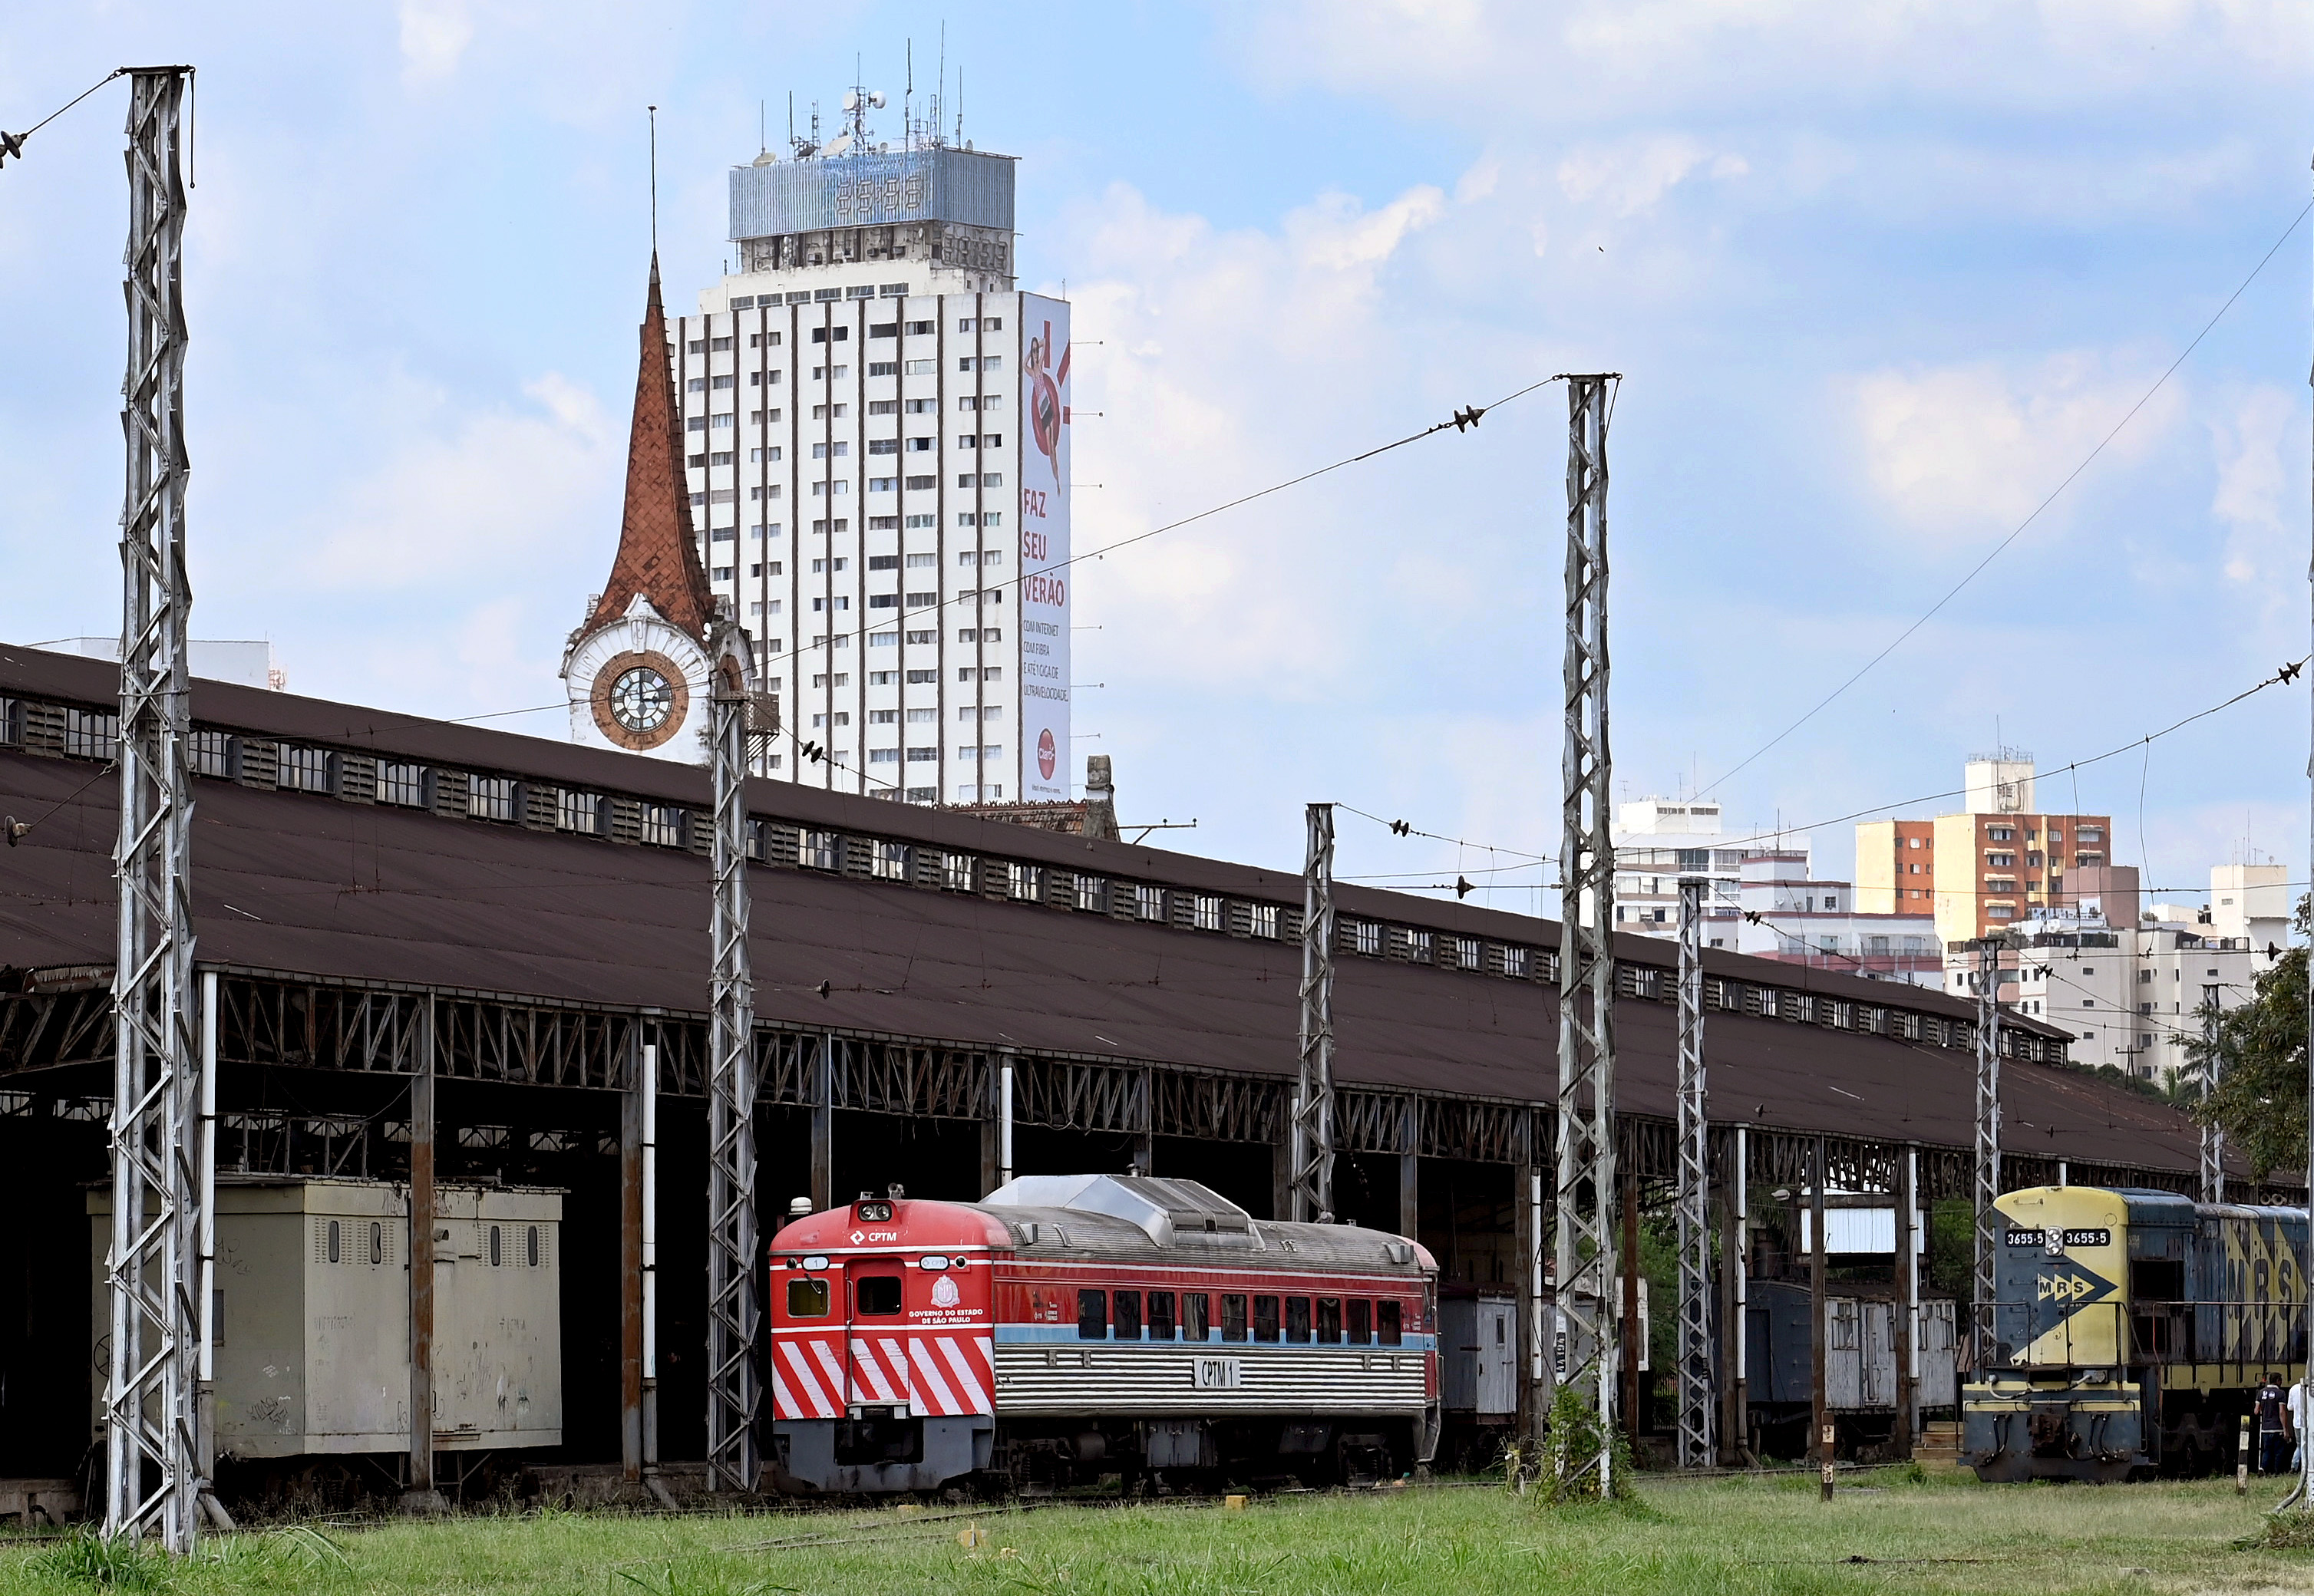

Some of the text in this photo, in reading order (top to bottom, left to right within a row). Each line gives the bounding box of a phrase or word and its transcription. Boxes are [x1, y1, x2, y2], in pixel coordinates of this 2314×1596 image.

[1024, 488, 1046, 518] FAZ
[1023, 530, 1046, 561] SEU
[1024, 572, 1064, 607] VERÃO
[1024, 620, 1058, 636] COM INTERNET
[1024, 641, 1050, 656] COM FIBRA
[868, 1232, 897, 1242] CPTM
[2039, 1281, 2084, 1293] MRS
[1202, 1360, 1233, 1387] CPTM 1
